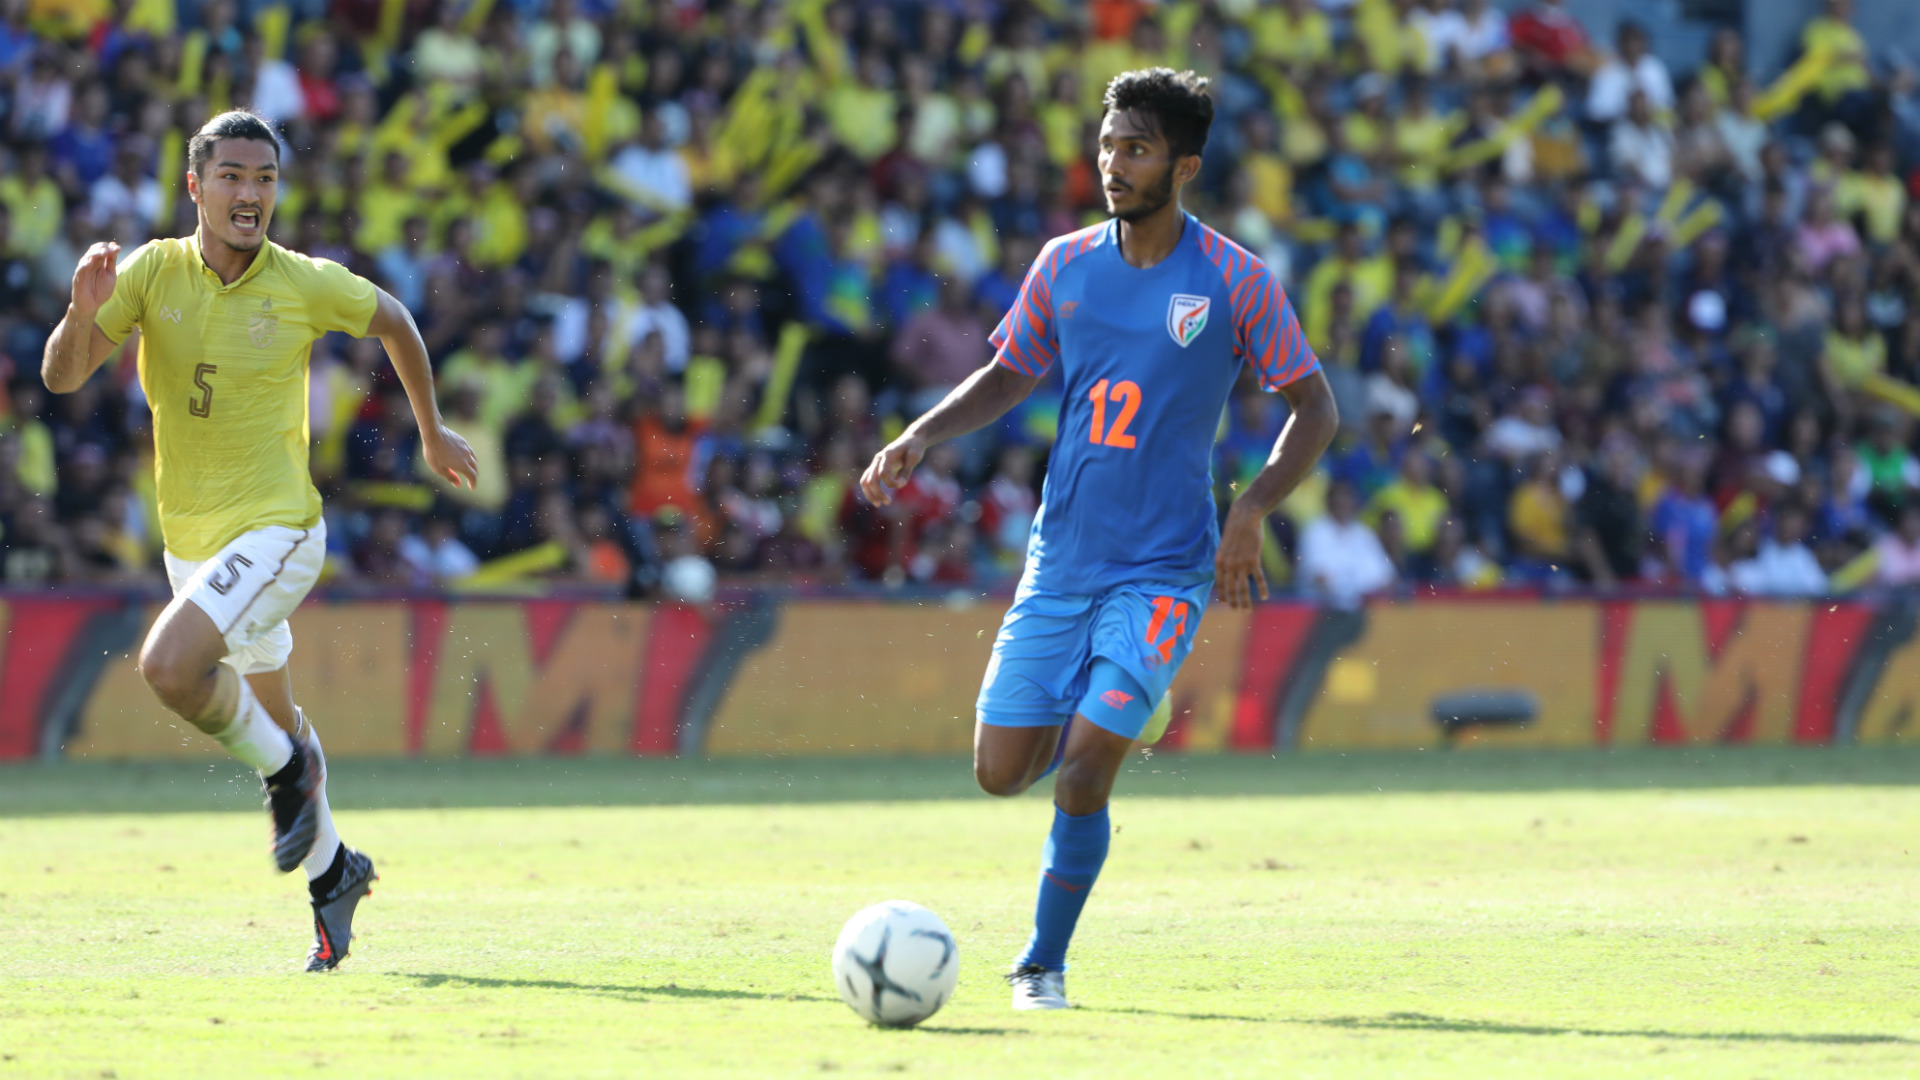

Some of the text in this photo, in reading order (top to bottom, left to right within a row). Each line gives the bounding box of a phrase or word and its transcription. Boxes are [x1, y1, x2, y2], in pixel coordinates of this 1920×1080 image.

[189, 362, 217, 418] 5
[1089, 378, 1142, 449] 12
[208, 553, 254, 595] 5
[1144, 595, 1189, 664] 12
